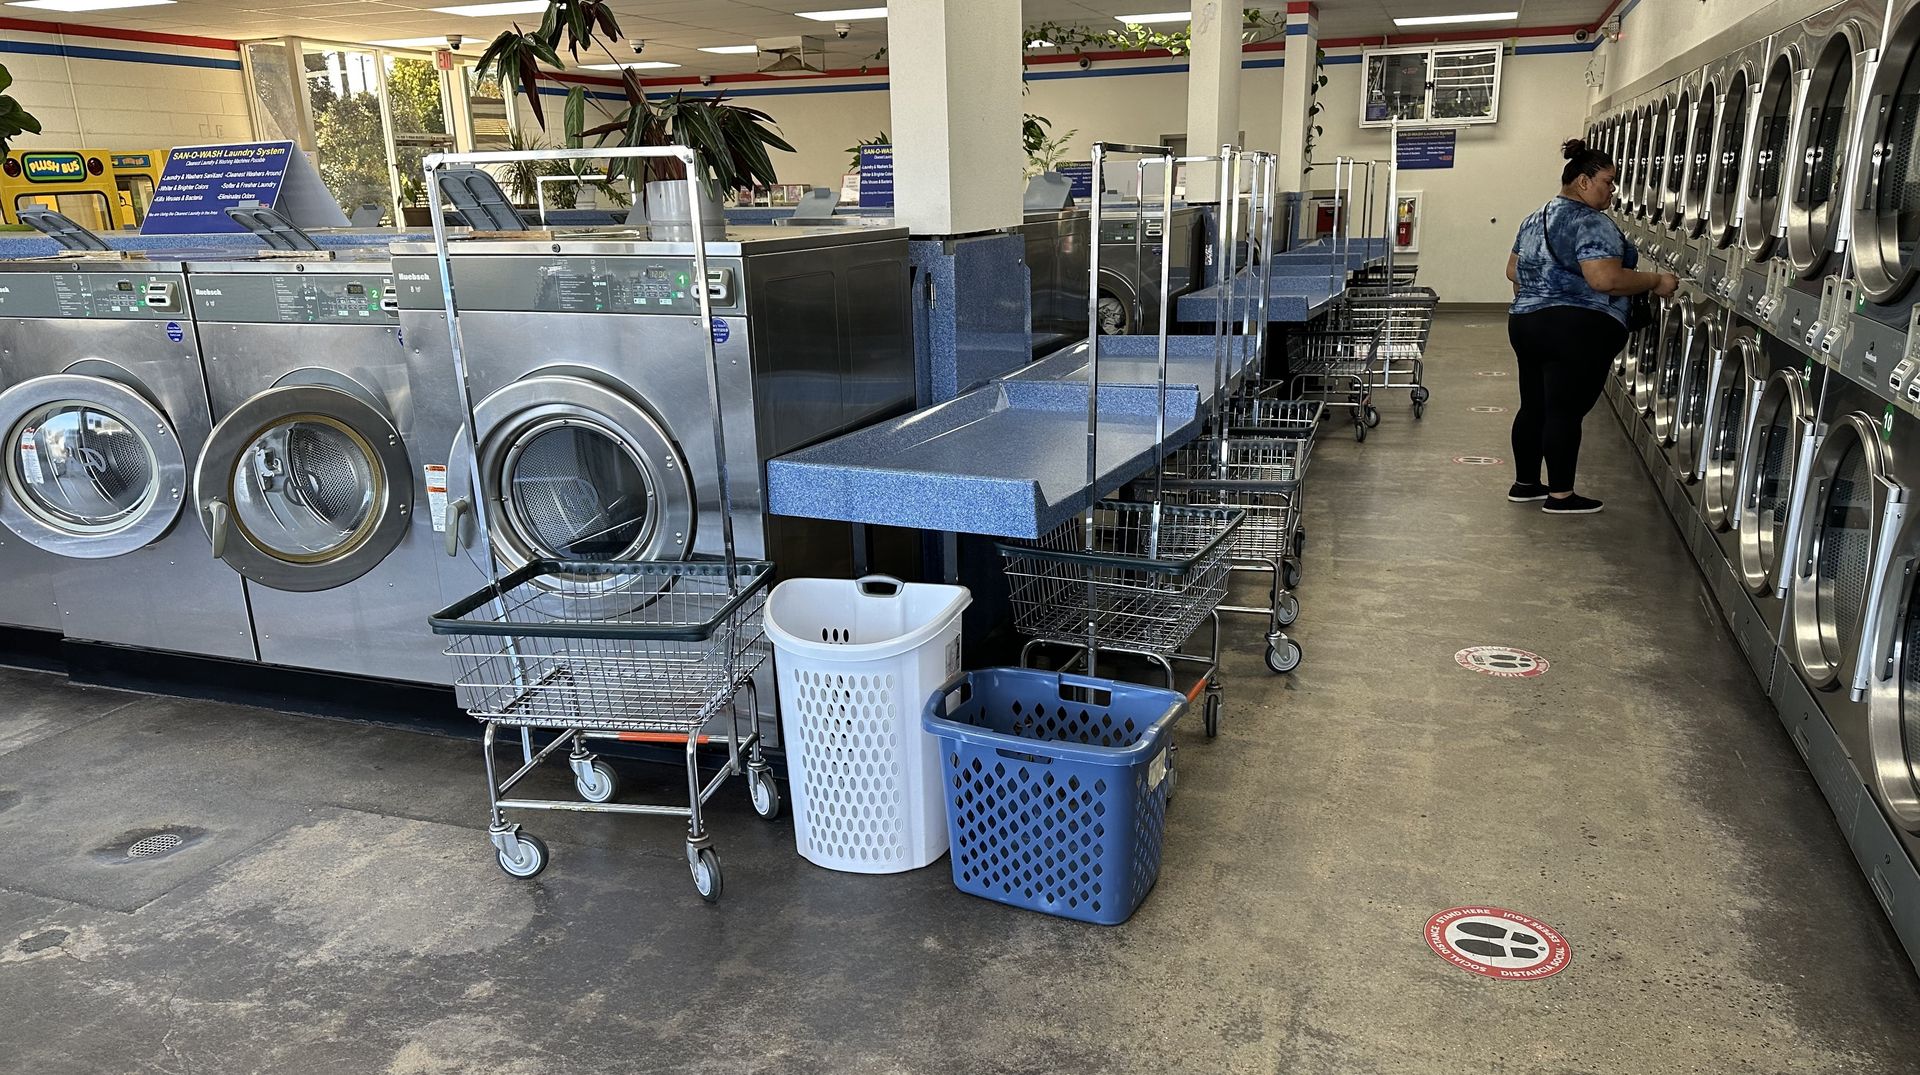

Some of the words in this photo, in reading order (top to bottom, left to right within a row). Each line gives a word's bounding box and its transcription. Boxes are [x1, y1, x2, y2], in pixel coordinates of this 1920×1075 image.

[172, 149, 223, 160] SAN-O-WASH
[224, 148, 255, 158] Laundry
[256, 147, 285, 157] System
[28, 160, 60, 173] PLUSH
[61, 160, 80, 174] BUS
[678, 275, 684, 284] 1
[372, 290, 378, 298] 2
[1804, 366, 1812, 381] 12
[1884, 412, 1893, 432] 10
[1436, 910, 1462, 924] STAND
[1430, 925, 1451, 955] DISTANCE
[1530, 922, 1560, 944] ESPERE
[1450, 954, 1487, 972] SOCIAL
[1551, 946, 1564, 967] SOCIAL
[1501, 964, 1553, 977] DISTANCIA
